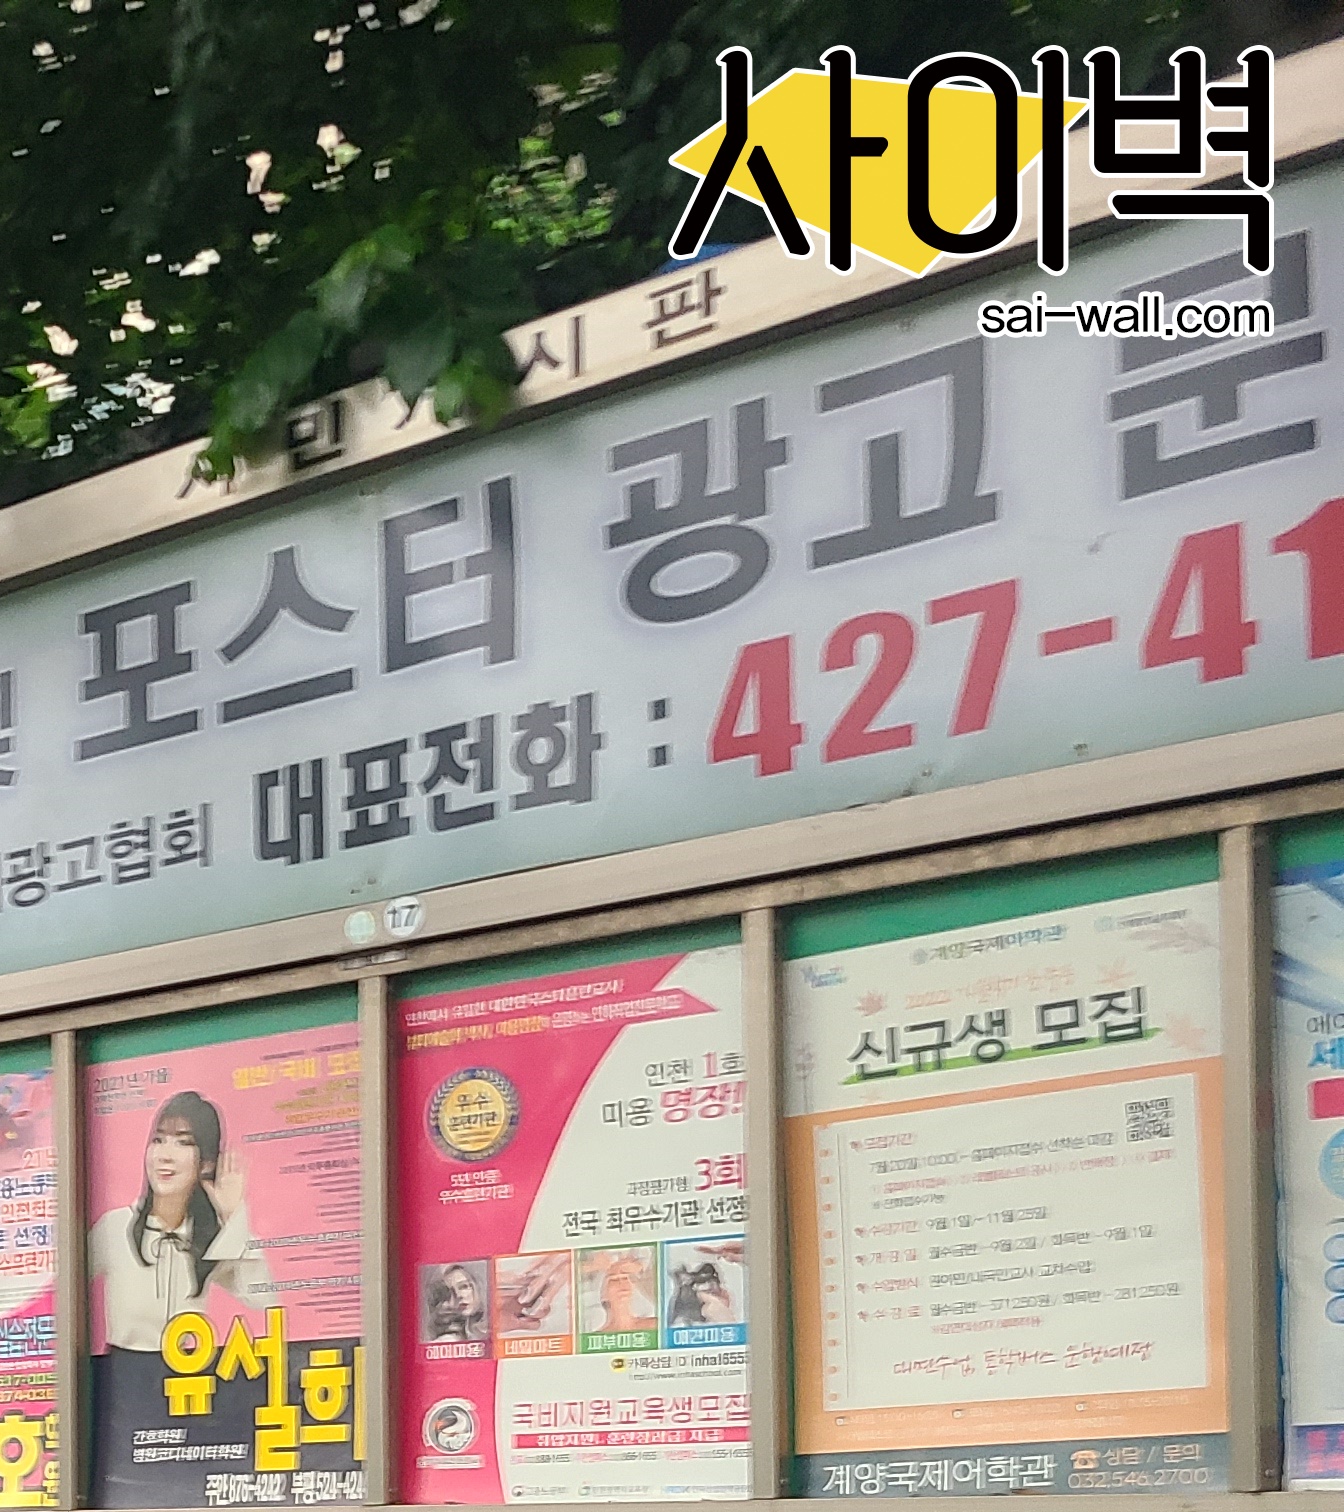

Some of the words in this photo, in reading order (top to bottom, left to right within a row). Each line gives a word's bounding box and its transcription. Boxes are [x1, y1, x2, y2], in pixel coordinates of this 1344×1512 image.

[74, 473, 519, 763] 포스터
[600, 334, 1002, 627] 광고
[253, 691, 606, 866] 대표전화
[846, 1006, 1011, 1080] 신규생
[1033, 986, 1149, 1052] 모집
[646, 1060, 693, 1087] 인천
[703, 1050, 746, 1080] 1호
[455, 1092, 494, 1112] 우수
[602, 1096, 654, 1128] 미용
[562, 1210, 602, 1238] 전국
[606, 1200, 703, 1234] 최우수기관
[504, 1337, 564, 1355] 네일아트
[587, 1332, 652, 1351] 피부미용
[673, 1327, 738, 1346] 애견미용
[512, 1394, 750, 1429] 국비지원교육생모집
[822, 1453, 1058, 1496] 계양국제어학관
